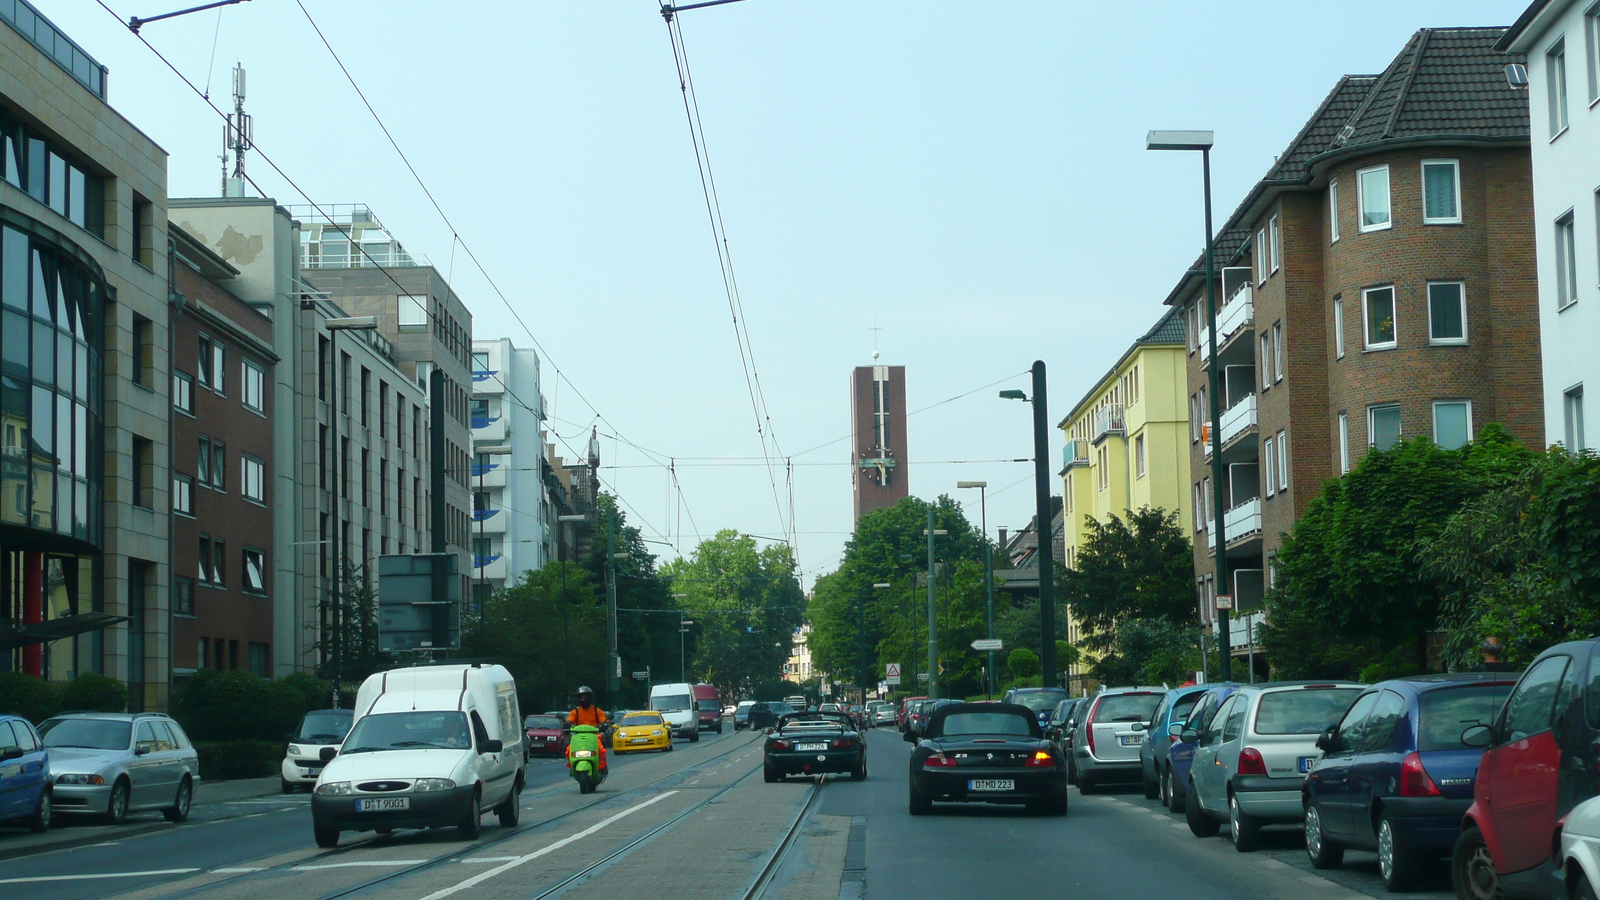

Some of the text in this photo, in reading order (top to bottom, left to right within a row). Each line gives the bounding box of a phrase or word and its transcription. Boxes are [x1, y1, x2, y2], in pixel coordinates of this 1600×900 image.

[1306, 759, 1313, 770] D
[975, 781, 1012, 789] D MD 223
[1441, 778, 1472, 786] RENAULT
[364, 798, 406, 810] D T 9001
